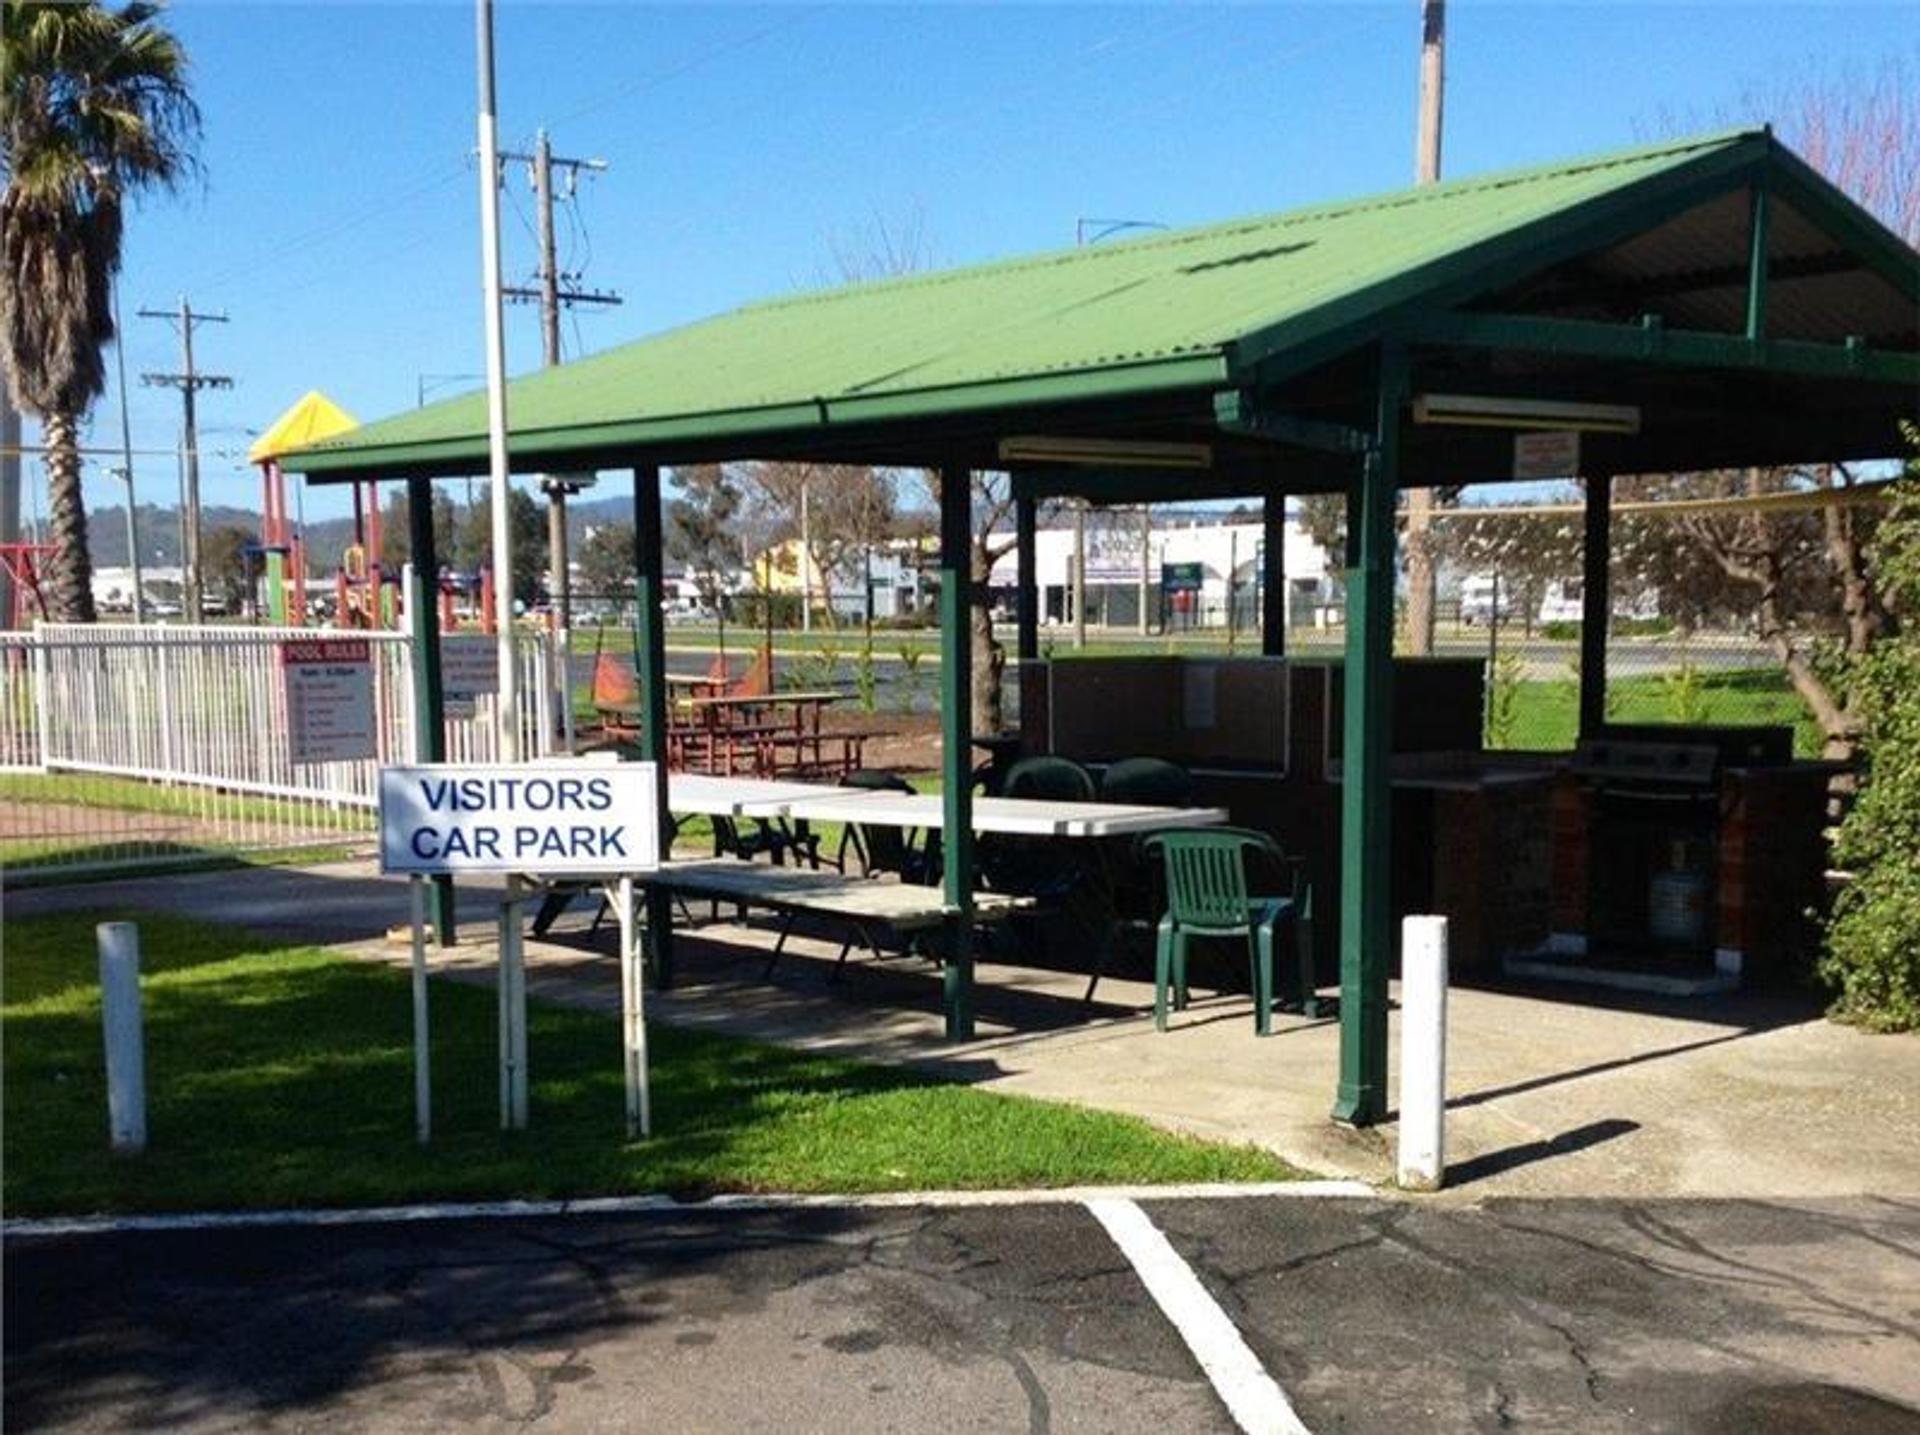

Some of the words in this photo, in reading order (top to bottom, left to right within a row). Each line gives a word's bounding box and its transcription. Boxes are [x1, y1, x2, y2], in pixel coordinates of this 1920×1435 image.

[421, 779, 612, 810] VISITORS
[411, 827, 501, 859] CAR
[515, 826, 627, 857] PARK
